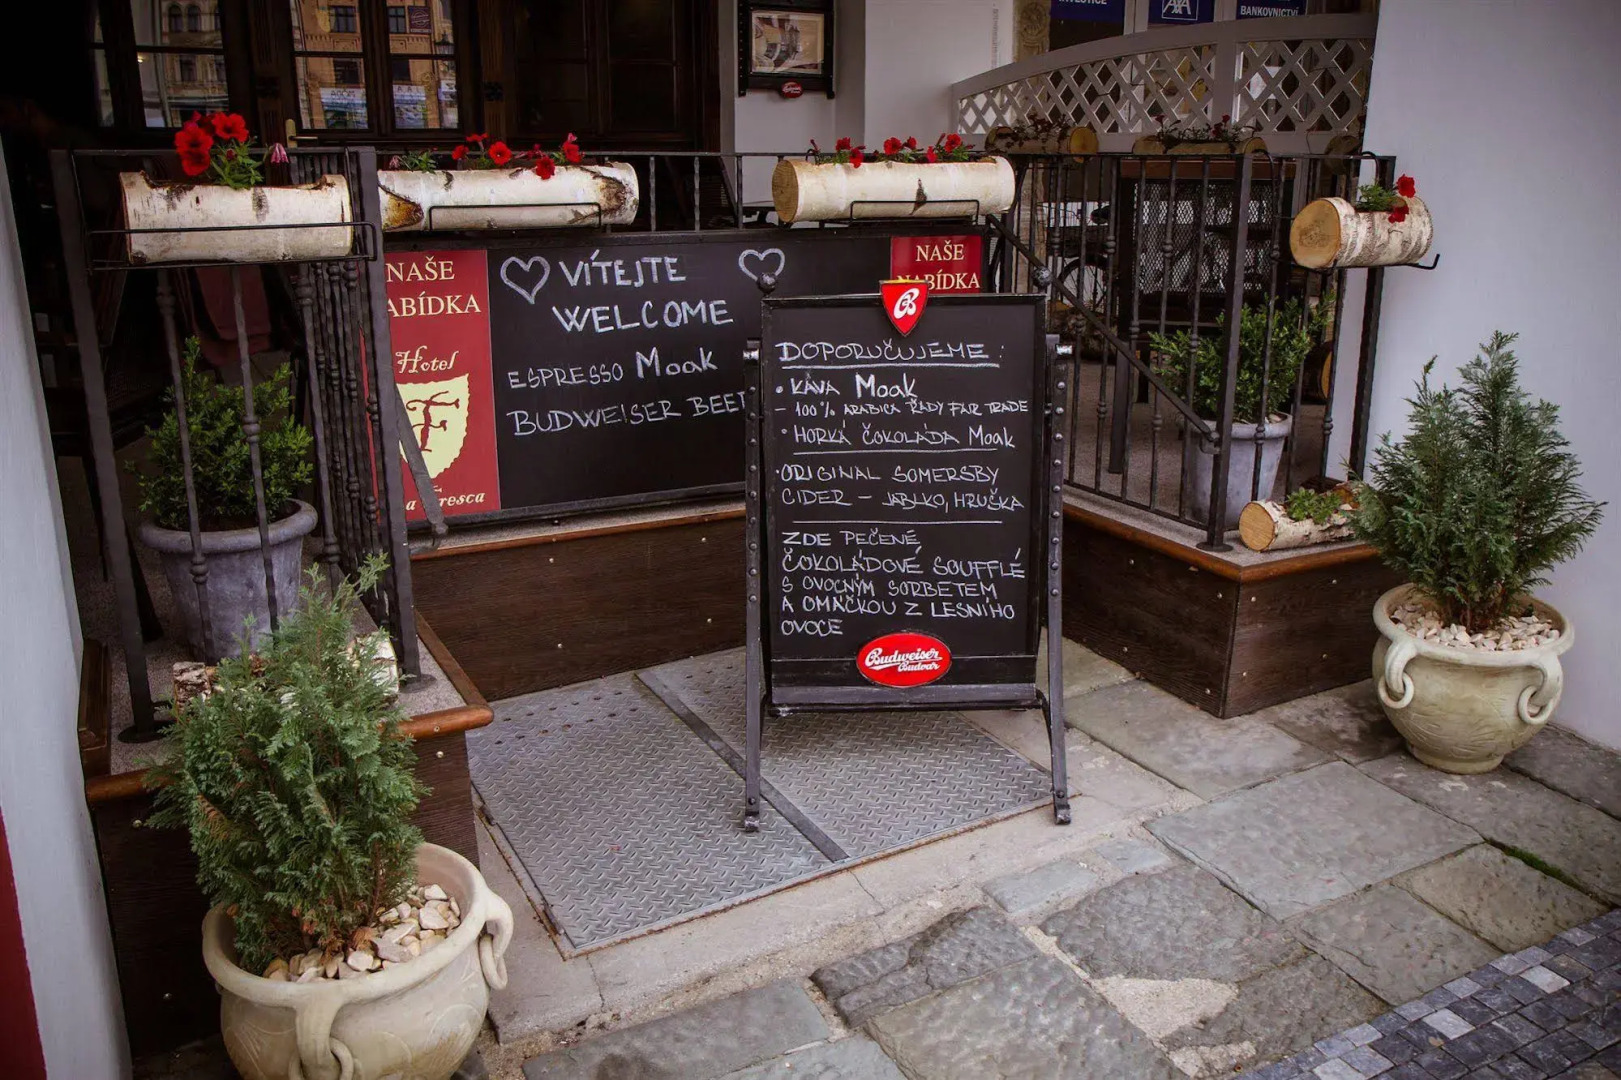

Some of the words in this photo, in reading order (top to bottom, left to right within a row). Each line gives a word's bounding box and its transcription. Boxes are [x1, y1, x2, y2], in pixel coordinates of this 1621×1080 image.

[915, 240, 964, 262] NAŠE
[385, 256, 455, 283] NAŠE
[558, 249, 686, 288] VÍTEJTE
[388, 291, 481, 318] ABÍDKA
[551, 299, 733, 333] WELCOME
[396, 346, 459, 374] Hotel
[774, 338, 989, 362] DOPORUČUJEME
[508, 363, 623, 389] ESPRESSO
[635, 347, 718, 378] Moak
[855, 371, 918, 399] Moak
[506, 400, 681, 436] BUDWEISER
[843, 403, 901, 416] ARABICA
[984, 400, 1029, 414] TRADE
[793, 420, 852, 445] HORKÁ
[862, 422, 960, 445] ČOKOLÁDA
[968, 424, 1015, 448] Moak
[781, 464, 882, 481] ORIGINAL
[891, 465, 999, 485] SOMERSBY
[433, 486, 486, 508] resca
[782, 488, 853, 506] CIDER
[954, 488, 1024, 511] HRUŠKA
[781, 531, 832, 546] ZDE
[839, 527, 921, 546] PEČENÉ
[782, 546, 924, 574] ČOKOLÁDOVÉ
[932, 547, 1025, 579] SOUFFLÉ
[781, 576, 793, 593] S
[802, 573, 876, 597] OVOCNÝM
[888, 580, 998, 600] SORBETEM
[782, 595, 794, 613] A
[802, 594, 896, 616] OMÁČKOU
[904, 601, 923, 616] Z
[930, 597, 1015, 619] LESNÍHO
[781, 619, 843, 637] OVOCE
[864, 647, 944, 671] Budweiser
[897, 661, 941, 673] Budvar
